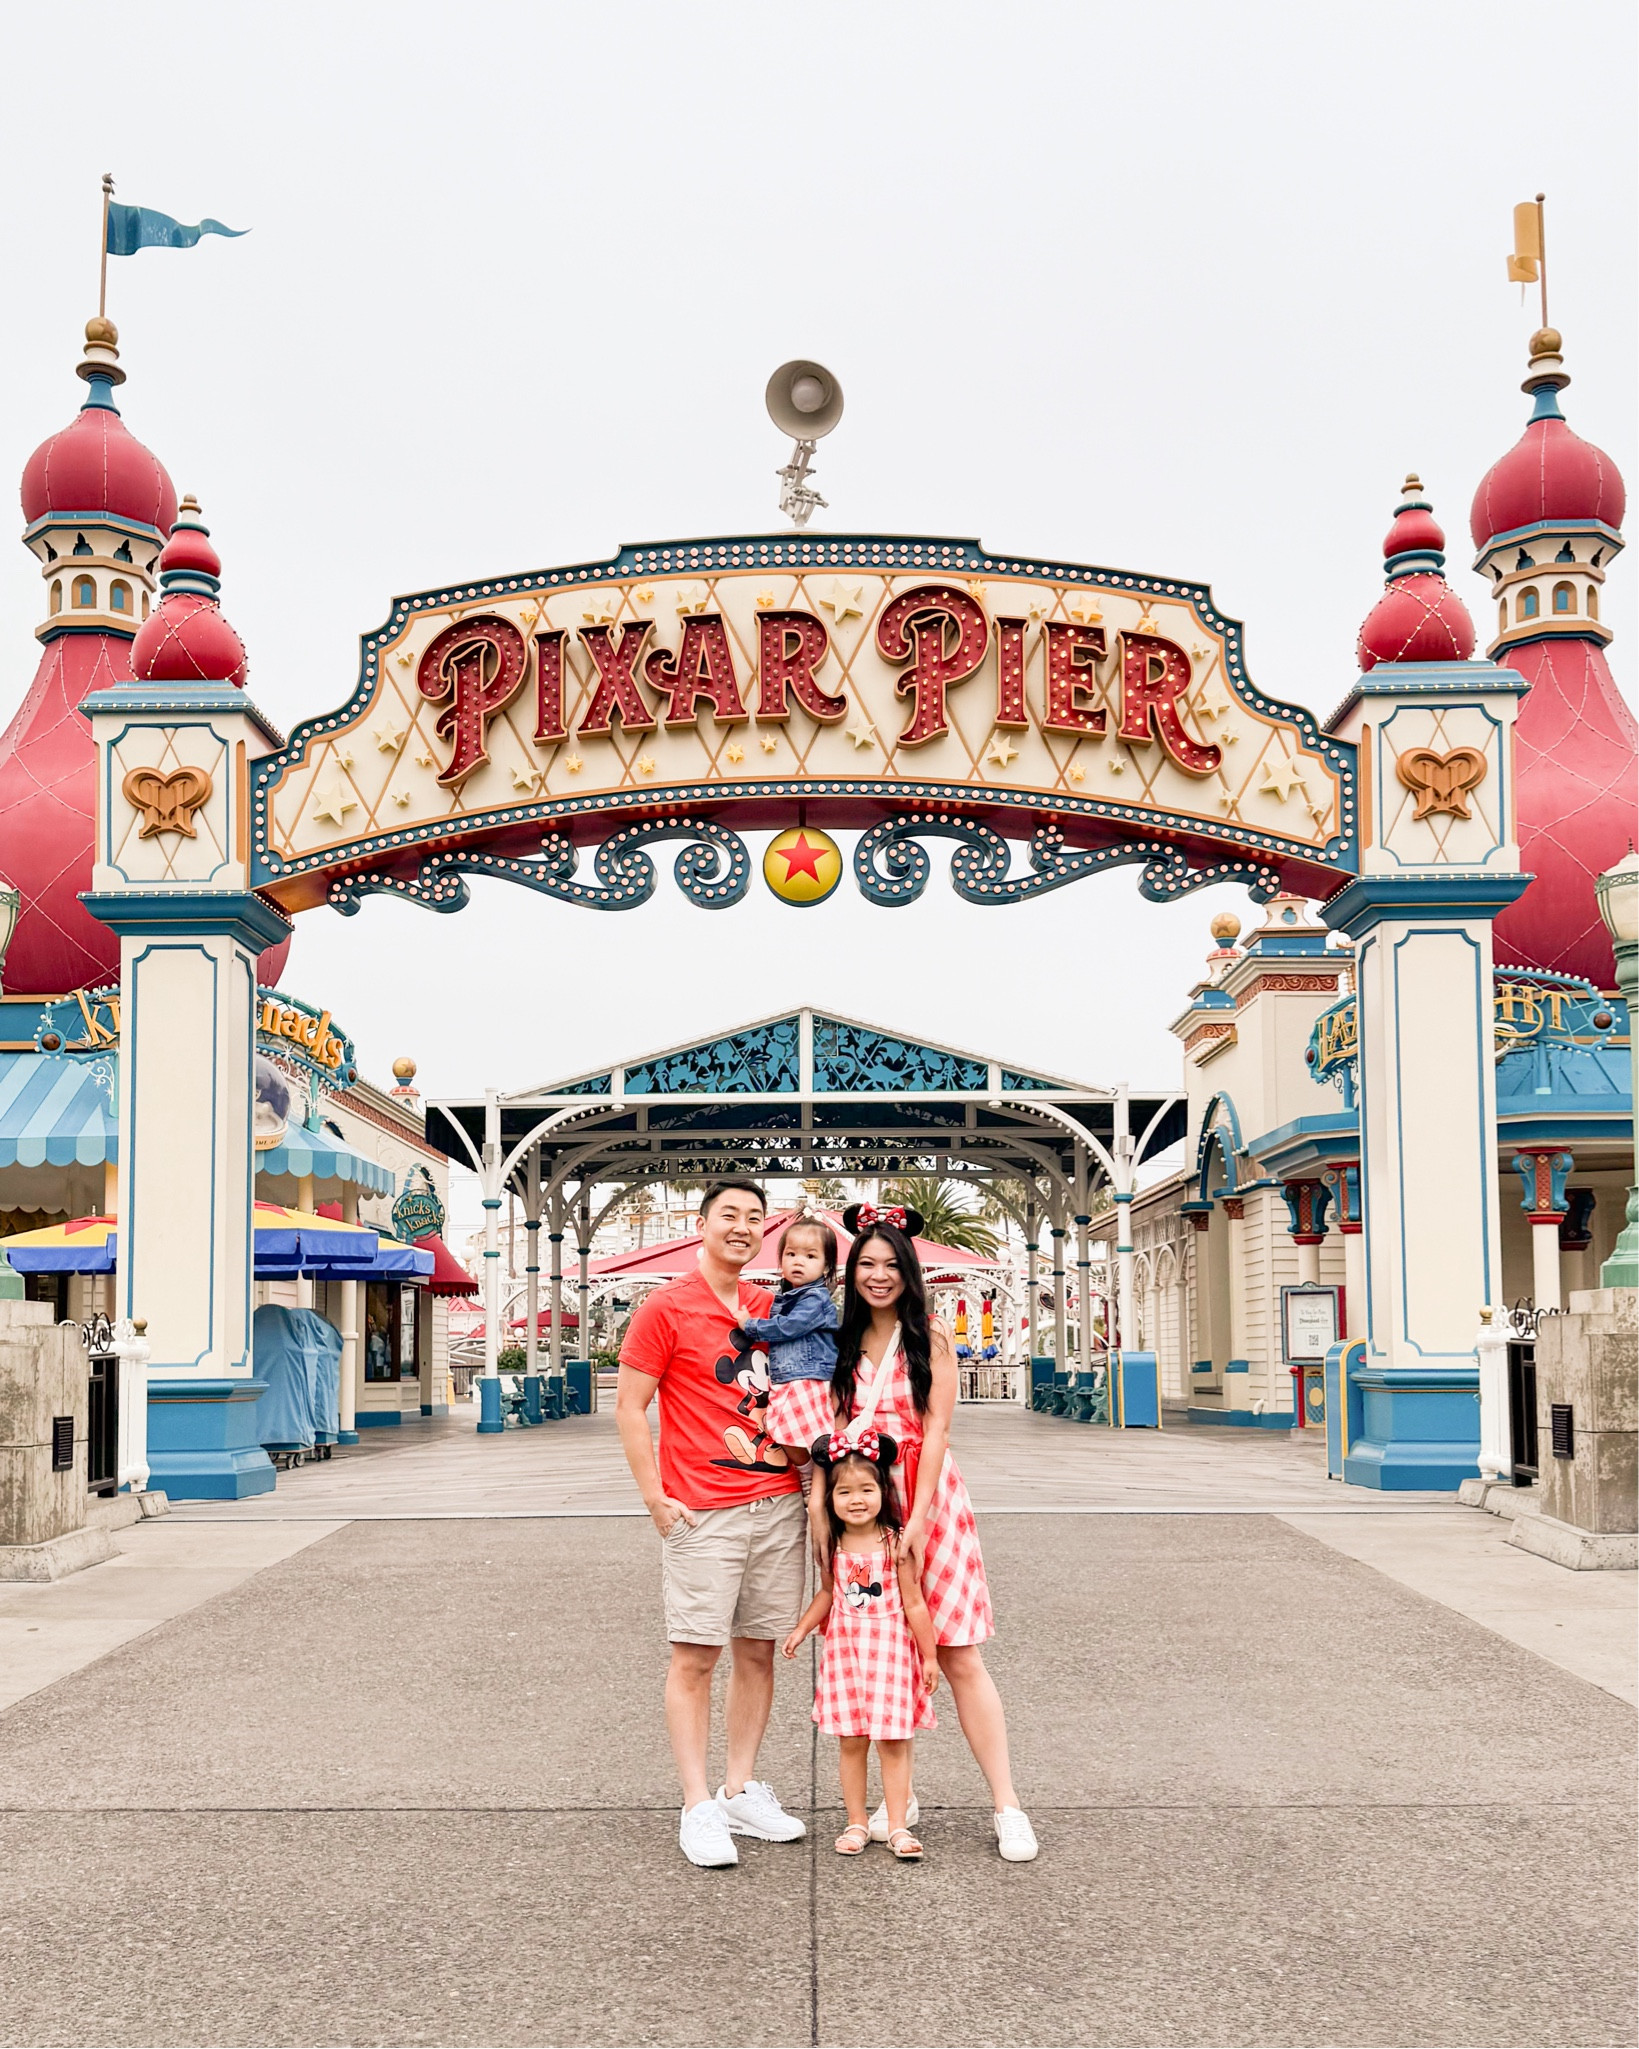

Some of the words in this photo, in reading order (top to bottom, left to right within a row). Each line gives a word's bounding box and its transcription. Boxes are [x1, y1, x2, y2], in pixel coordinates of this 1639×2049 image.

[415, 608, 849, 788] PIXAR
[874, 583, 1223, 778] PIER
[257, 996, 343, 1069] nacks
